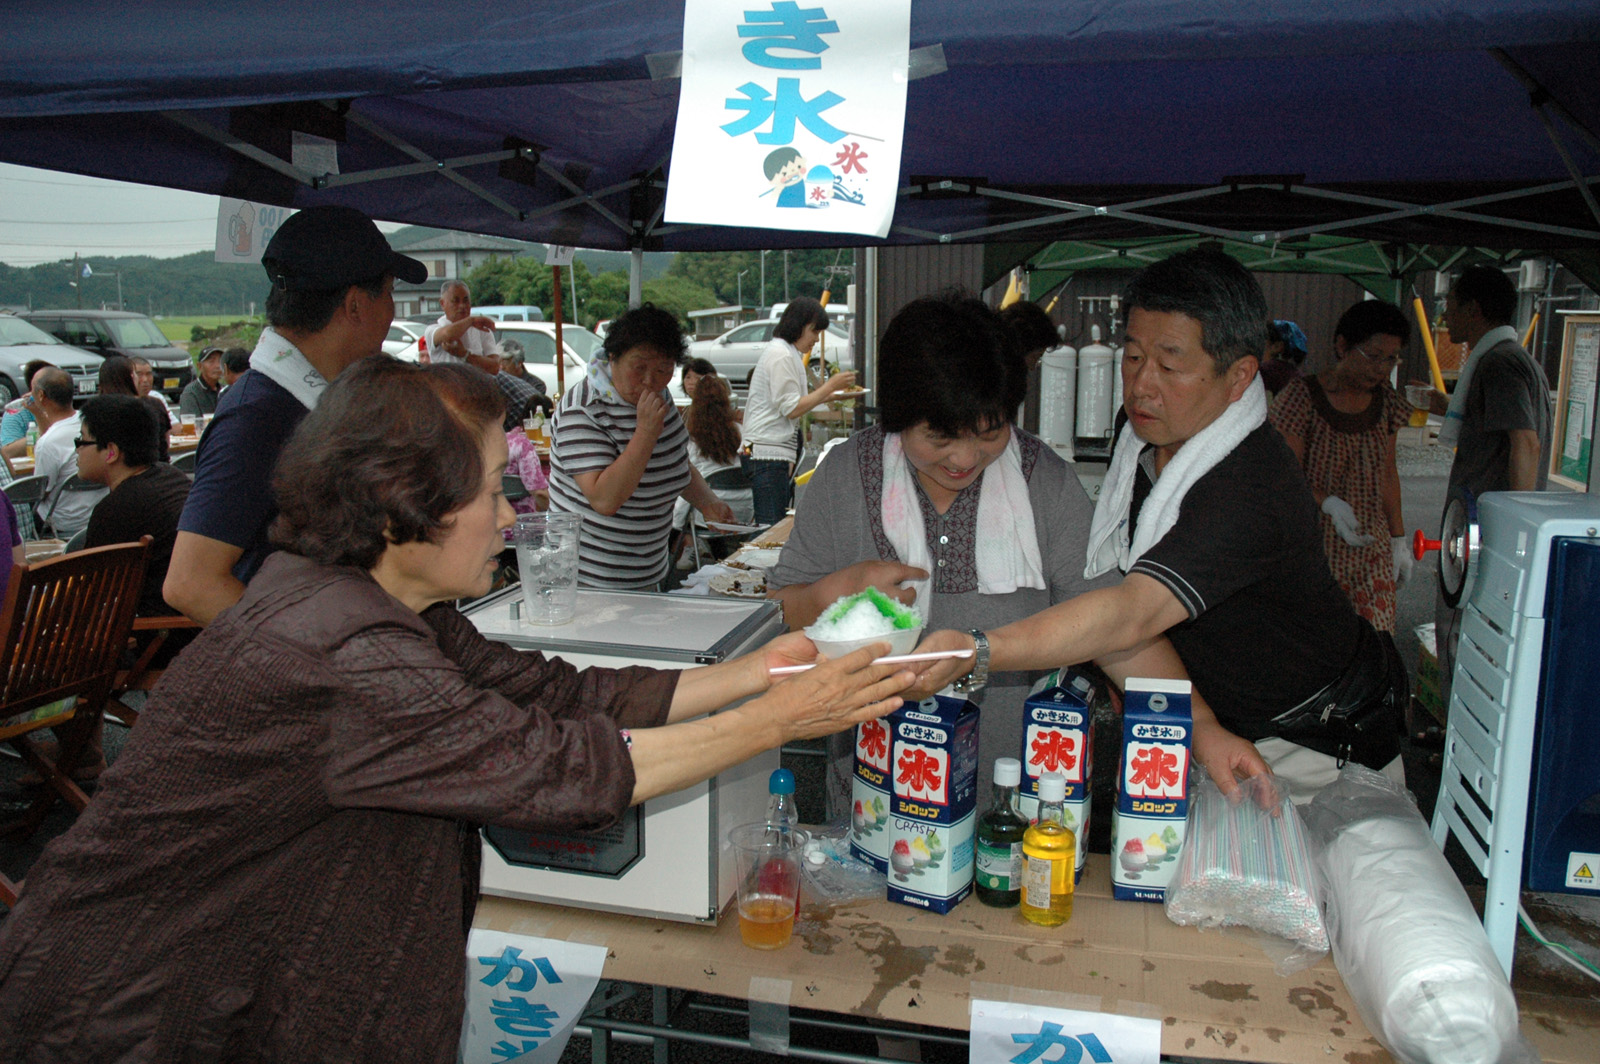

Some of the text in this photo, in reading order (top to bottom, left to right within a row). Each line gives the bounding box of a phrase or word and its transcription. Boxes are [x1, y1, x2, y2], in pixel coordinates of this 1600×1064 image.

[830, 142, 868, 174] 氷
[809, 186, 826, 201] 氷
[1036, 709, 1079, 724] かき氷用
[859, 719, 887, 760] 氷
[902, 725, 943, 743] かき氷用
[1137, 725, 1182, 739] かき氷用
[1029, 730, 1077, 772] 氷
[858, 765, 884, 785] シロップ
[896, 748, 942, 792] 氷
[1129, 747, 1180, 790] 氷
[899, 801, 940, 819] シロップ
[1132, 801, 1177, 813] シロップ
[895, 818, 937, 838] CRASH
[1009, 1020, 1113, 1064] か
